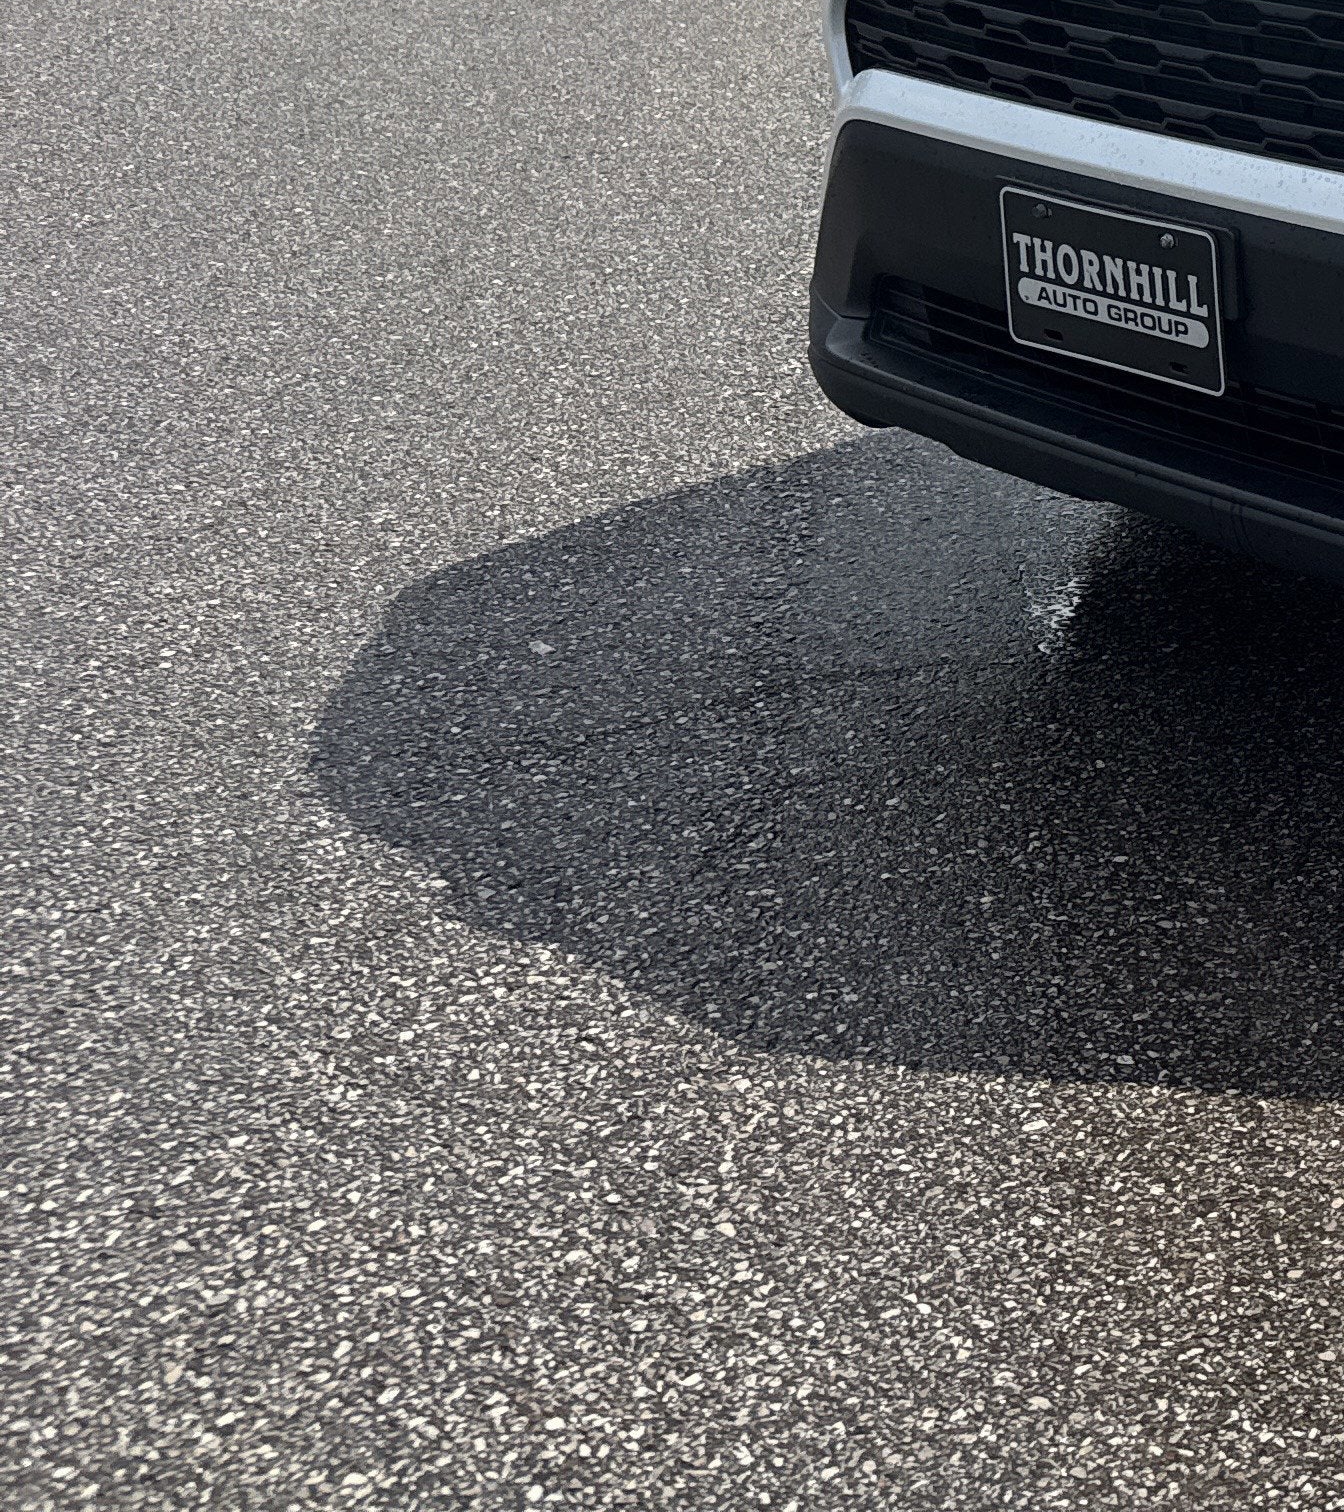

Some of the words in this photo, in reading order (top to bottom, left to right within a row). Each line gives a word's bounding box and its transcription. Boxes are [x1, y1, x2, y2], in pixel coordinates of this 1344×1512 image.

[1012, 232, 1209, 318] THORNHILL
[1037, 285, 1100, 317] AUTO
[1106, 302, 1190, 339] GROUP
